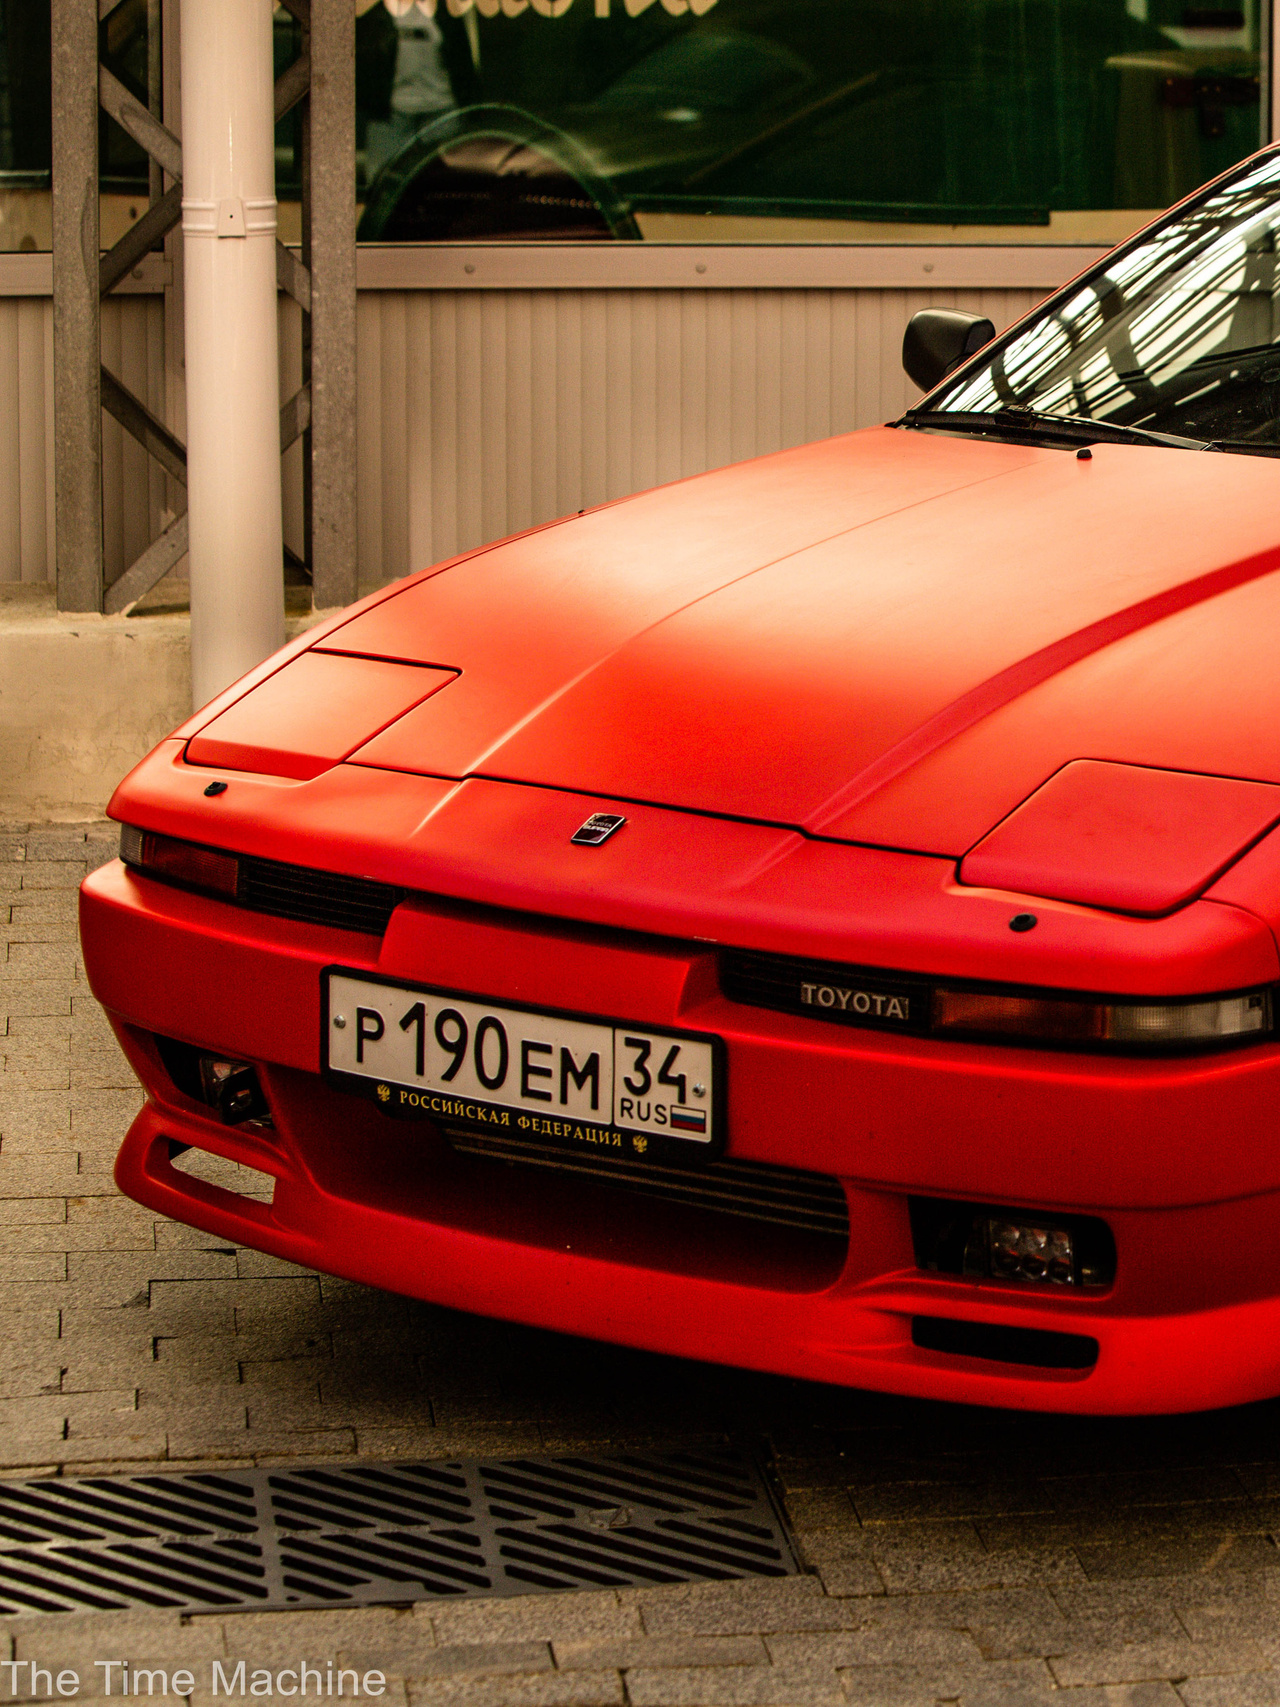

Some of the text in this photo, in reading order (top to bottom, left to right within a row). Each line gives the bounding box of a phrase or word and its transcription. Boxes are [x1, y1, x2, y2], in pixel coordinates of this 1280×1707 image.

[801, 983, 910, 1021] TOYOTA
[622, 1036, 688, 1105] 34
[398, 1089, 623, 1148] РОССИЙСКАЯ ФЕДЕРАЦИЯ
[619, 1097, 668, 1126] RUS
